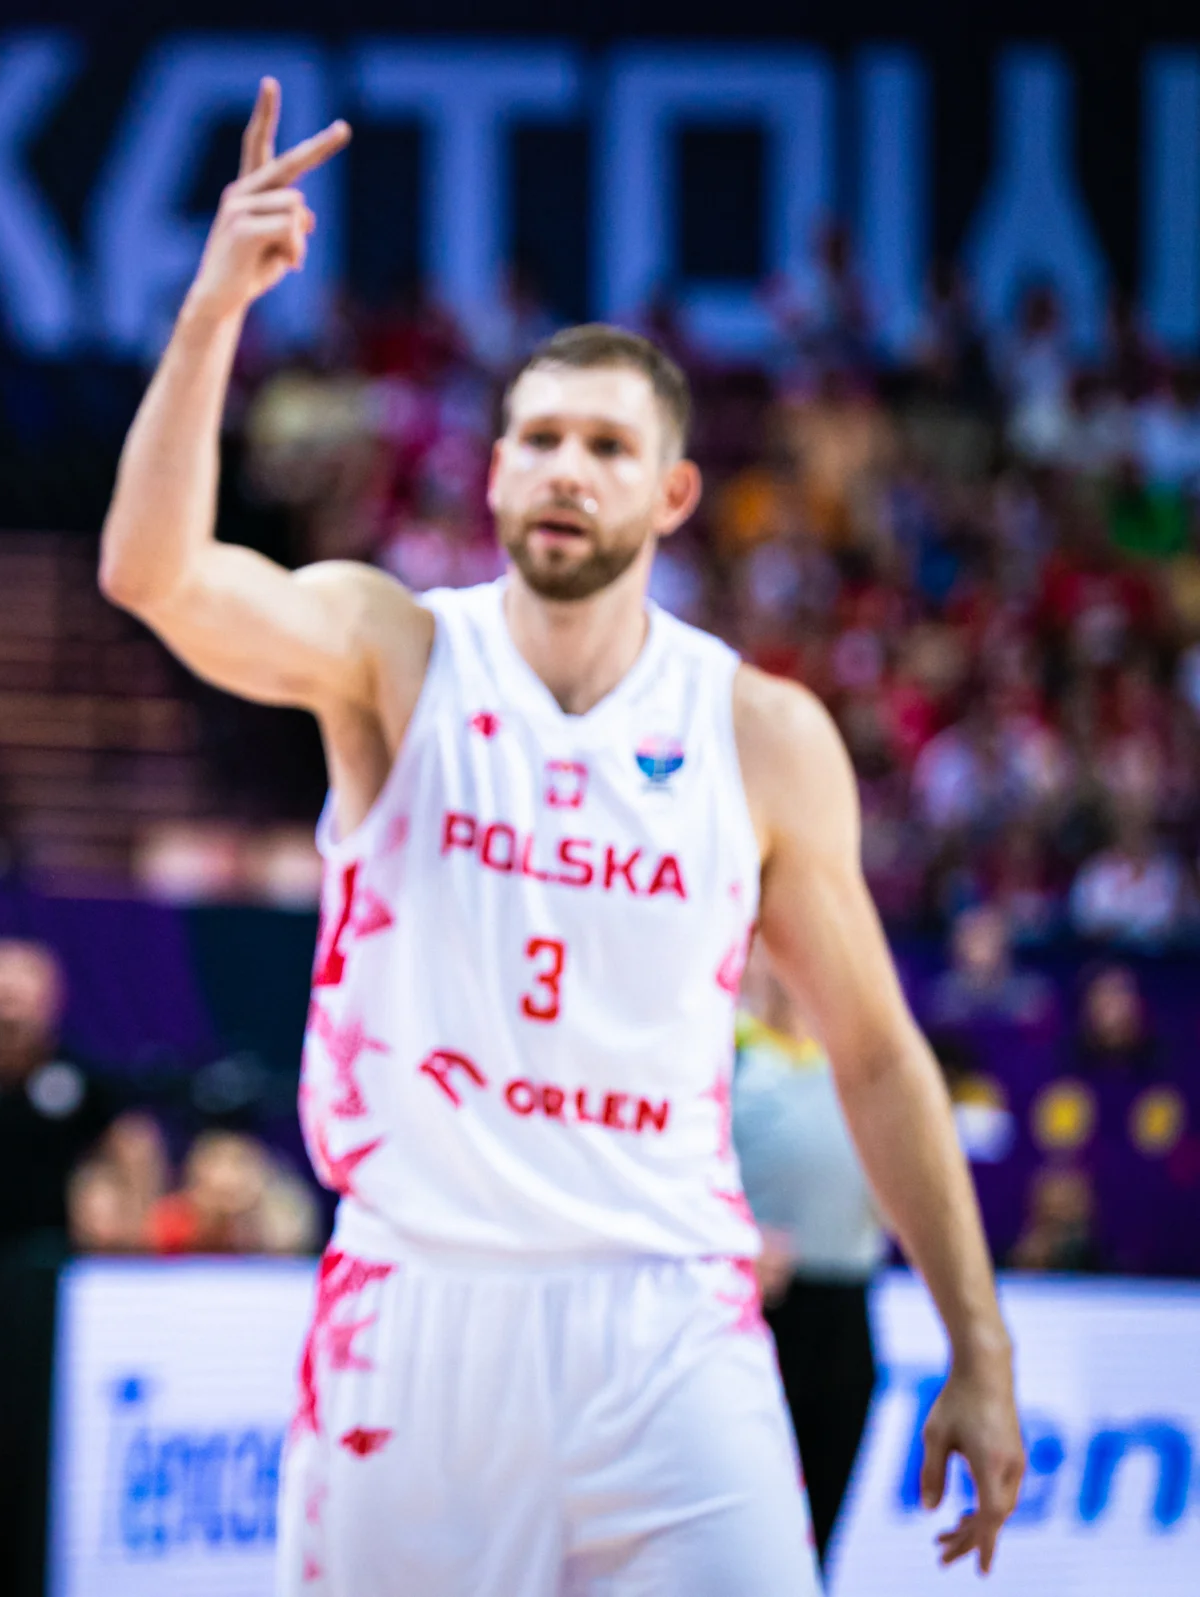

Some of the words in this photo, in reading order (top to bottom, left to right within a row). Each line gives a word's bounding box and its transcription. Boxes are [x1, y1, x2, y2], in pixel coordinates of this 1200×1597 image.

[441, 811, 688, 900] POLSKA
[520, 937, 566, 1022] 3
[504, 1078, 670, 1133] ORLEN
